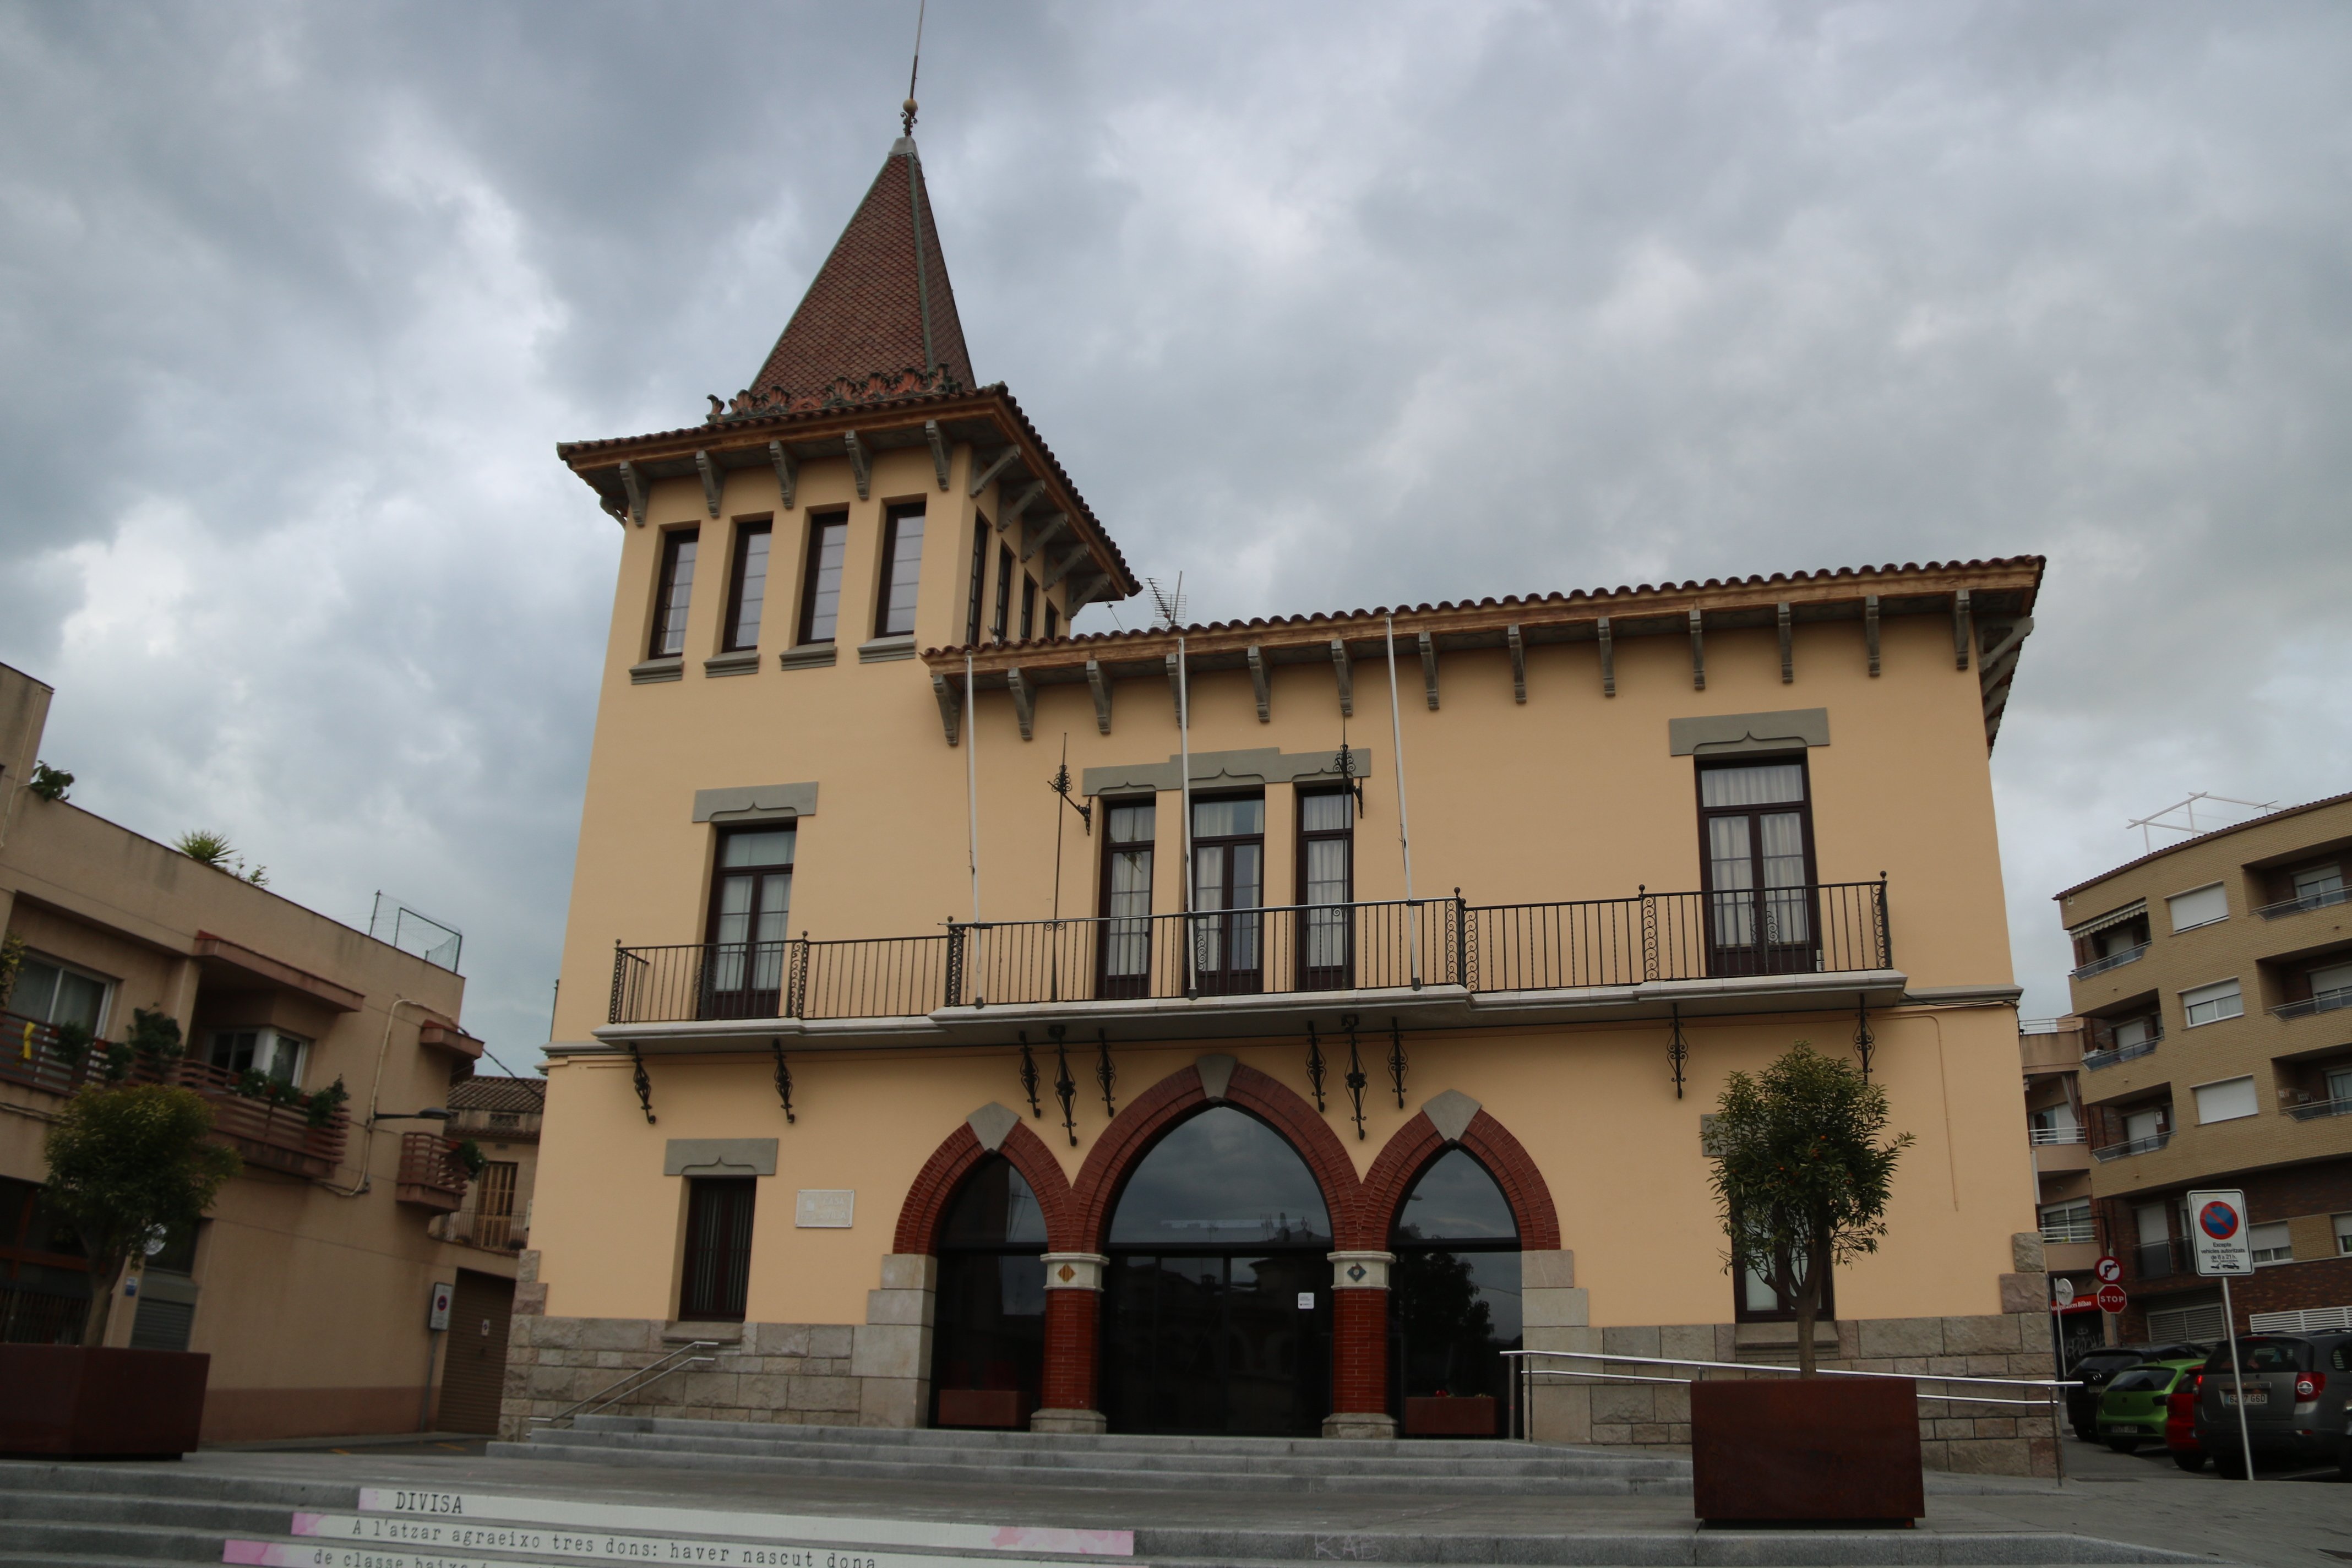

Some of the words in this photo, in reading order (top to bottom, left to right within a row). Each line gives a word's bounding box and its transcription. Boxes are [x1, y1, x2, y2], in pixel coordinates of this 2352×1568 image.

[396, 1491, 463, 1515] DIVISA
[352, 1520, 361, 1534] A
[374, 1520, 441, 1541] l'atzar
[451, 1529, 540, 1548] agraeixo
[553, 1533, 594, 1552] tres
[606, 1538, 658, 1556] dons:
[670, 1543, 729, 1561] haver
[743, 1550, 813, 1567] nascut
[827, 1553, 875, 1568] dona
[314, 1549, 333, 1565] de
[343, 1551, 404, 1568] classe
